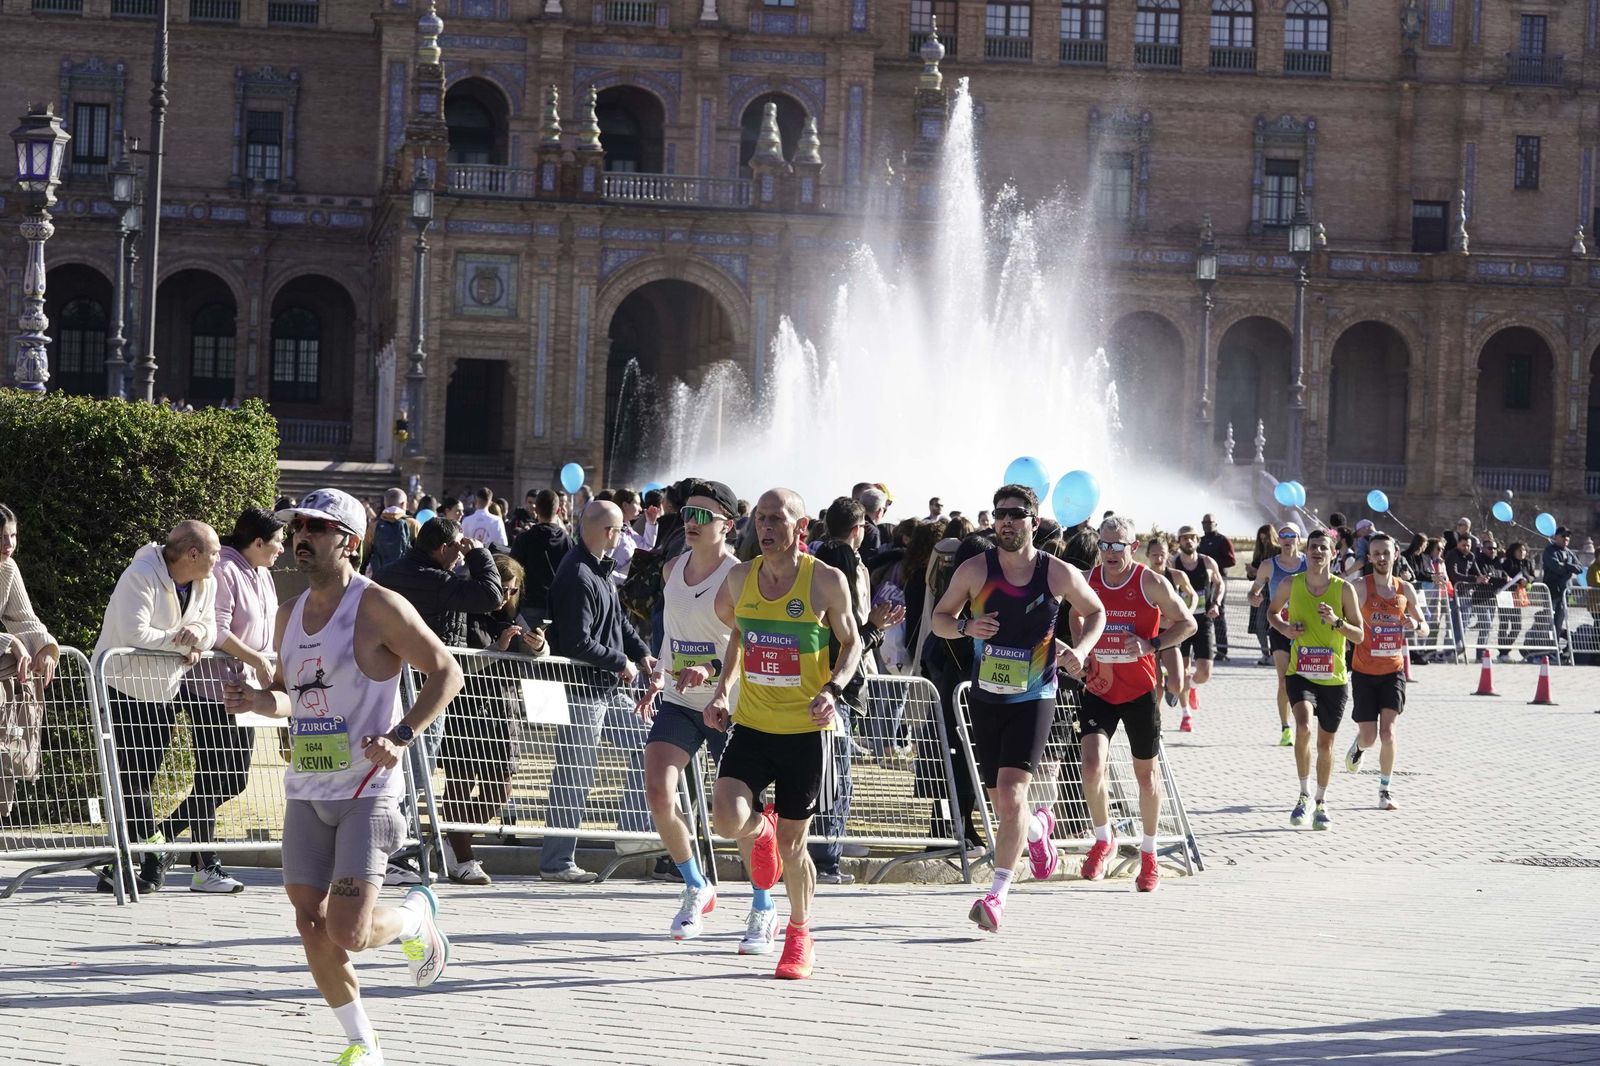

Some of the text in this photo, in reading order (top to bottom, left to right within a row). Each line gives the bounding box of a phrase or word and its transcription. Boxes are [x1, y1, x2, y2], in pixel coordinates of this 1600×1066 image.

[760, 635, 792, 645] ZURICH
[681, 645, 709, 653] ZURICH
[995, 648, 1025, 658] ZURICH
[761, 651, 778, 660] 1427
[761, 661, 780, 674] LEE
[995, 663, 1010, 671] 1820
[1300, 664, 1330, 672] VINCENT
[991, 672, 1010, 684] ASA
[300, 722, 338, 732] ZURICH
[305, 743, 323, 752] 1644
[300, 755, 334, 770] KEVIN
